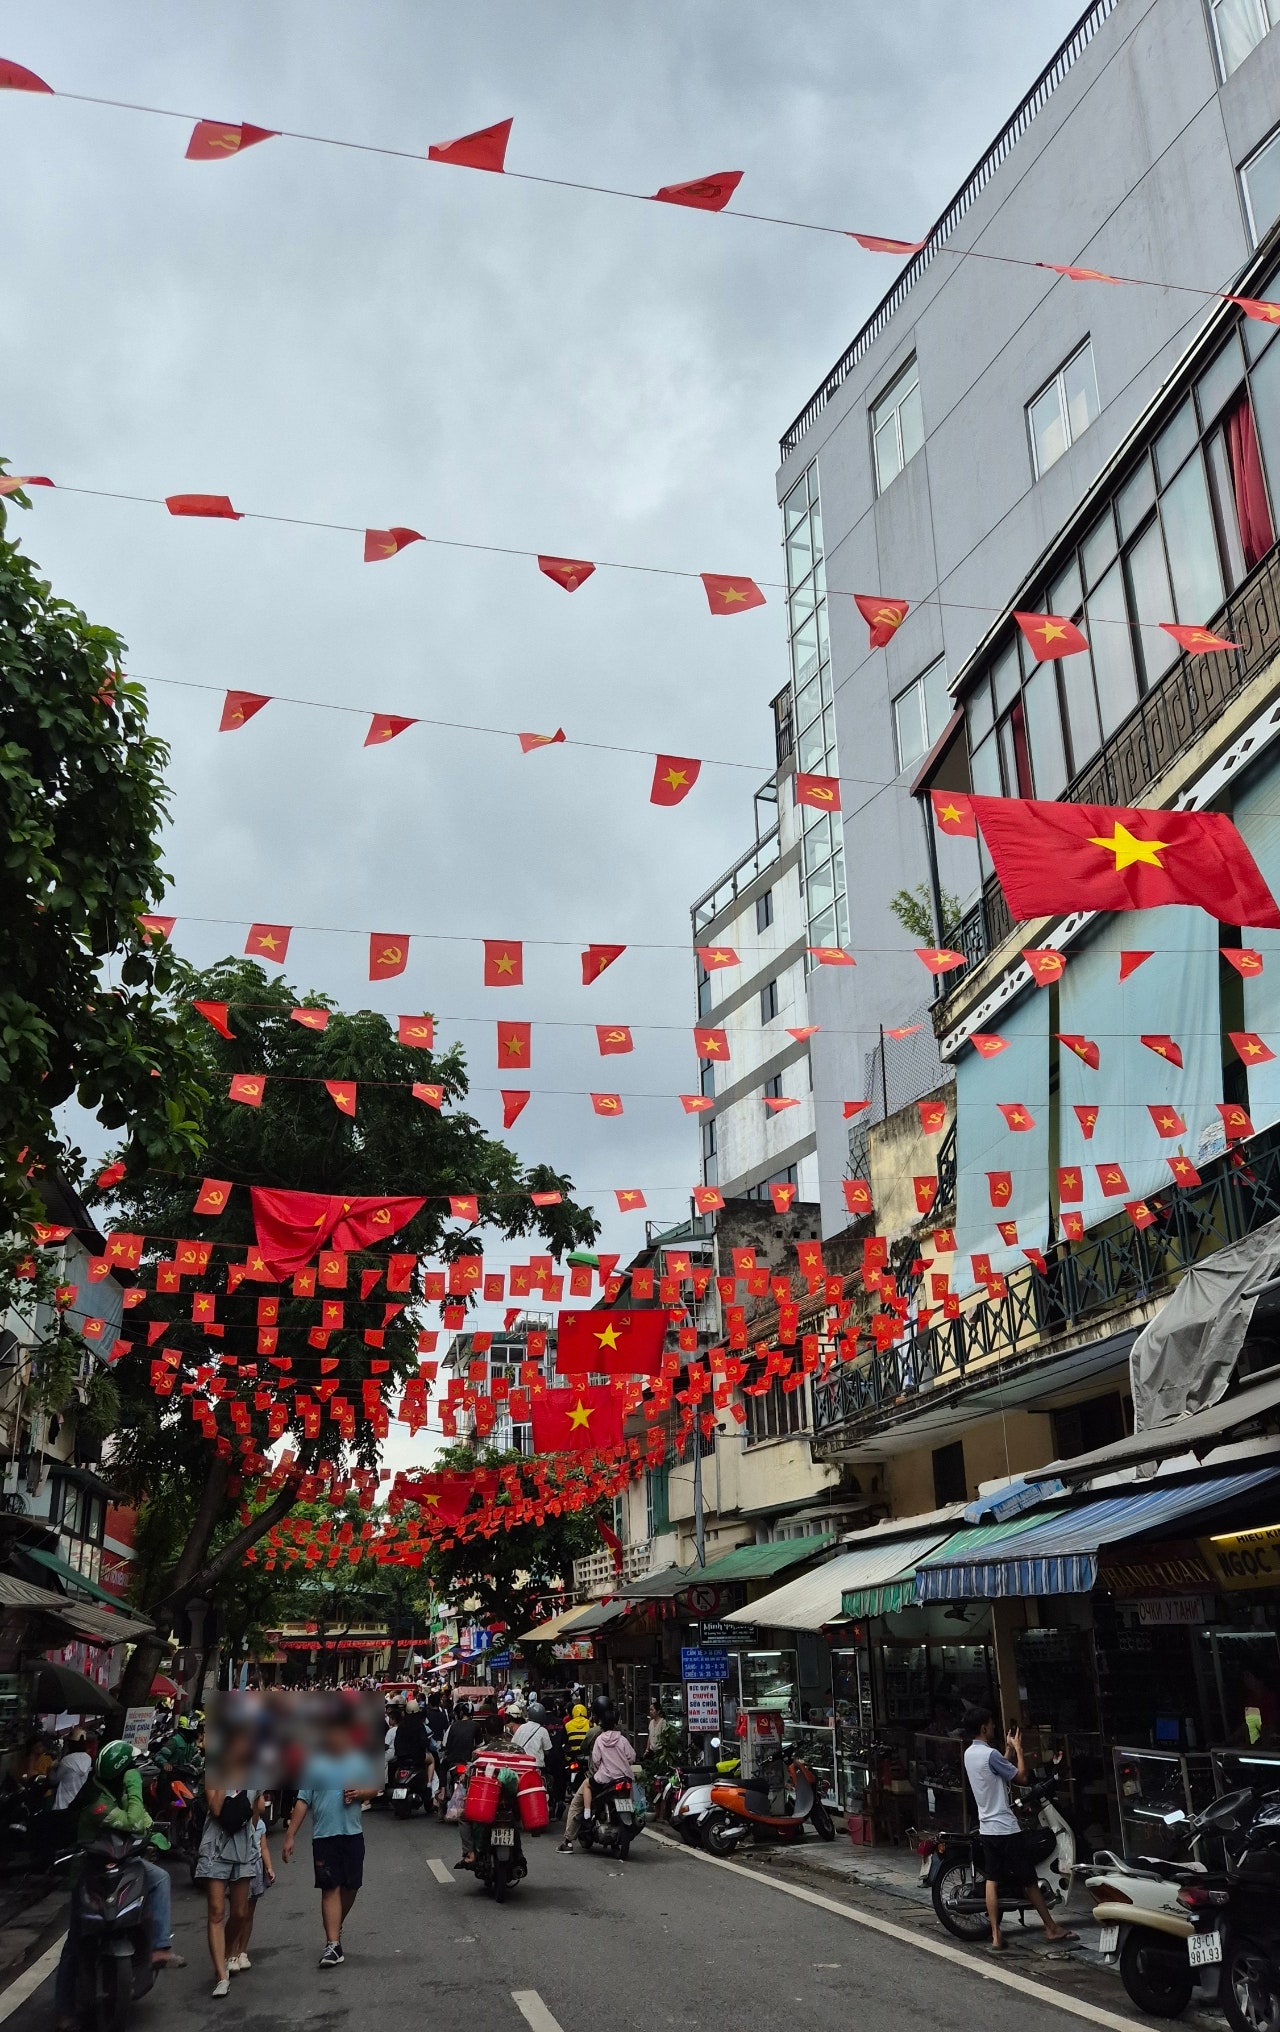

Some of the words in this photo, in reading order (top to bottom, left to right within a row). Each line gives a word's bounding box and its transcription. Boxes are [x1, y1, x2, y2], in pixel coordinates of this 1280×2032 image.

[114, 1755, 129, 1770] Grab
[1192, 1934, 1215, 1950] 29-C1
[1190, 1947, 1220, 1964] 981.93
